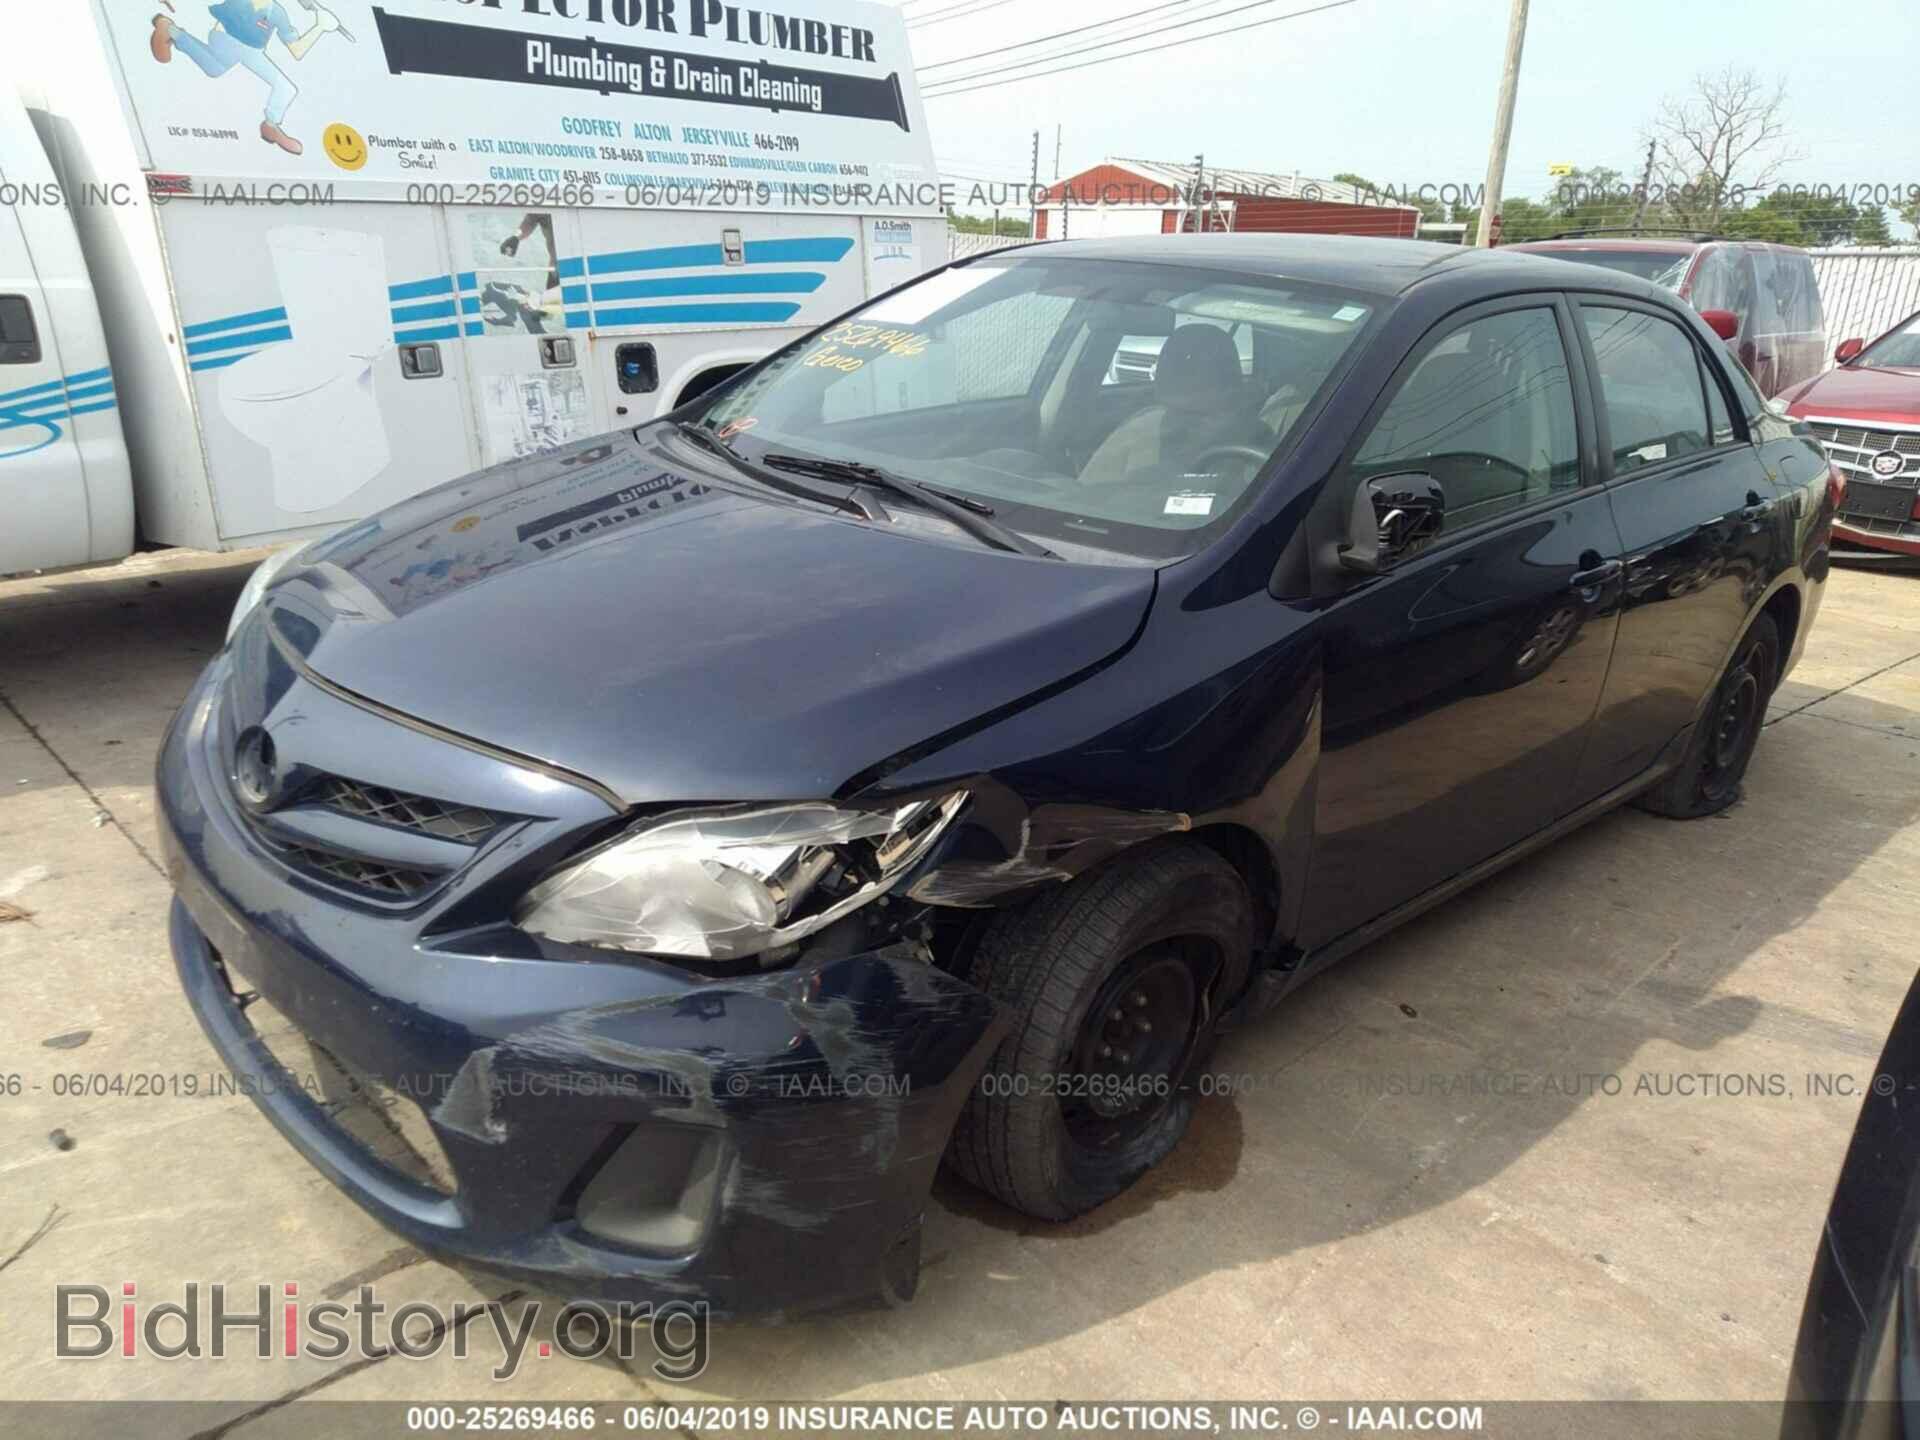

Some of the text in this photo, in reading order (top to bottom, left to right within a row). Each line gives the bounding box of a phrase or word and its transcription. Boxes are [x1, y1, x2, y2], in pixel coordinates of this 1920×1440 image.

[689, 0, 877, 62] PLUMBER
[526, 39, 823, 112] Plumbing & Drain Cleaning
[368, 134, 417, 149] Plumber
[421, 138, 446, 151] with
[560, 116, 800, 153] GODFREY ALTON JERSEYVILLE 466-2199
[398, 151, 438, 170] Smile!
[468, 138, 495, 153] EAST
[497, 141, 597, 160] ALTON/WOODRIVER
[599, 147, 644, 163] 258-8658
[645, 150, 689, 166] BETHALTO
[690, 153, 728, 168] 377-5532
[490, 166, 535, 182] GRANITE
[538, 168, 560, 182] CITY
[563, 170, 601, 185] 451-6115
[874, 220, 912, 232] A.O.Smith
